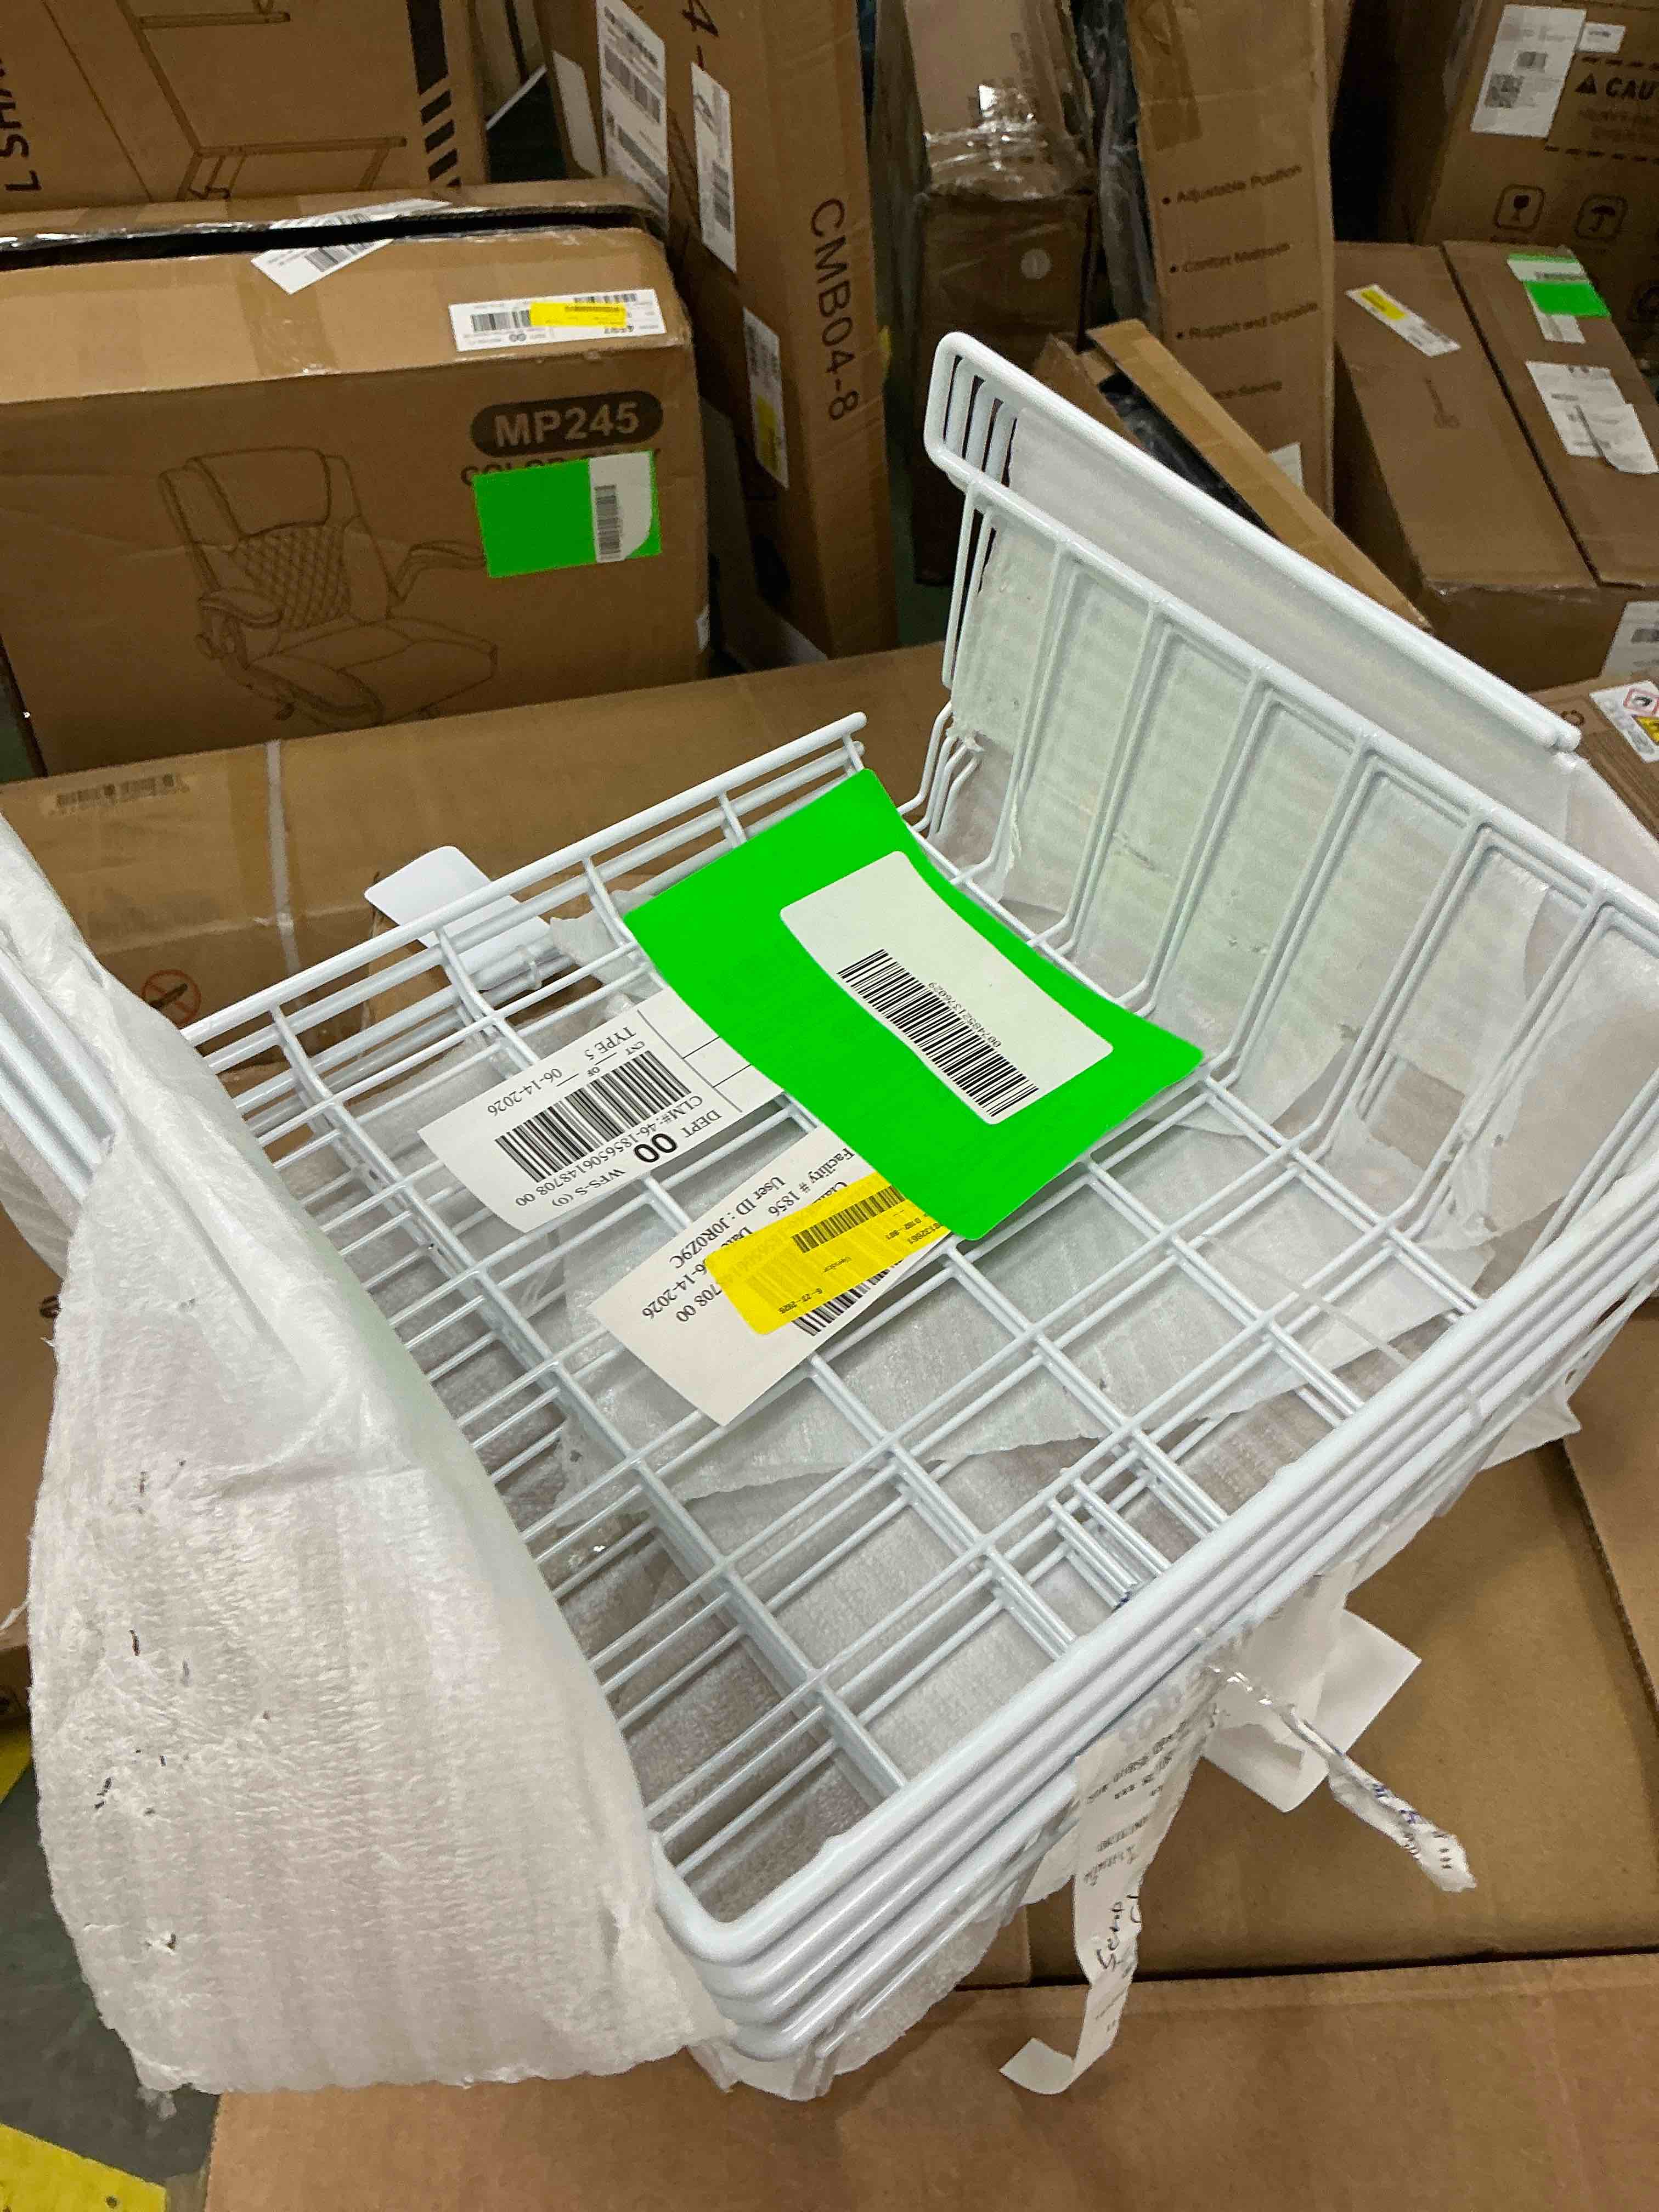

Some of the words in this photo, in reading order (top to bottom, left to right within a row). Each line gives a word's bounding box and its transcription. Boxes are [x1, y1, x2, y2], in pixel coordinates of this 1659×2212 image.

[1606, 77, 1659, 100] CAU
[4, 170, 42, 192] L
[811, 198, 859, 421] CMB04-8
[494, 401, 641, 448] MP245
[595, 1026, 637, 1054] TYPE
[625, 1041, 646, 1056] CNT
[585, 1049, 595, 1060] 5
[488, 1068, 562, 1116] 06-14-2026
[681, 1110, 722, 1137] DEPT
[536, 1124, 656, 1195] 46-1856506148708
[634, 1133, 678, 1163] 00
[808, 1148, 855, 1184] Facility
[575, 1170, 626, 1195] WFS-S
[753, 1177, 786, 1200] User
[798, 1182, 811, 1193] #
[515, 1193, 536, 1206] 00
[551, 1194, 574, 1206] (0)
[736, 1198, 757, 1215] ID
[768, 1190, 800, 1217] 1856
[669, 1218, 730, 1269] J0R0Z9C
[642, 1259, 707, 1318] 6-14-2026
[675, 1305, 697, 1322] 00
